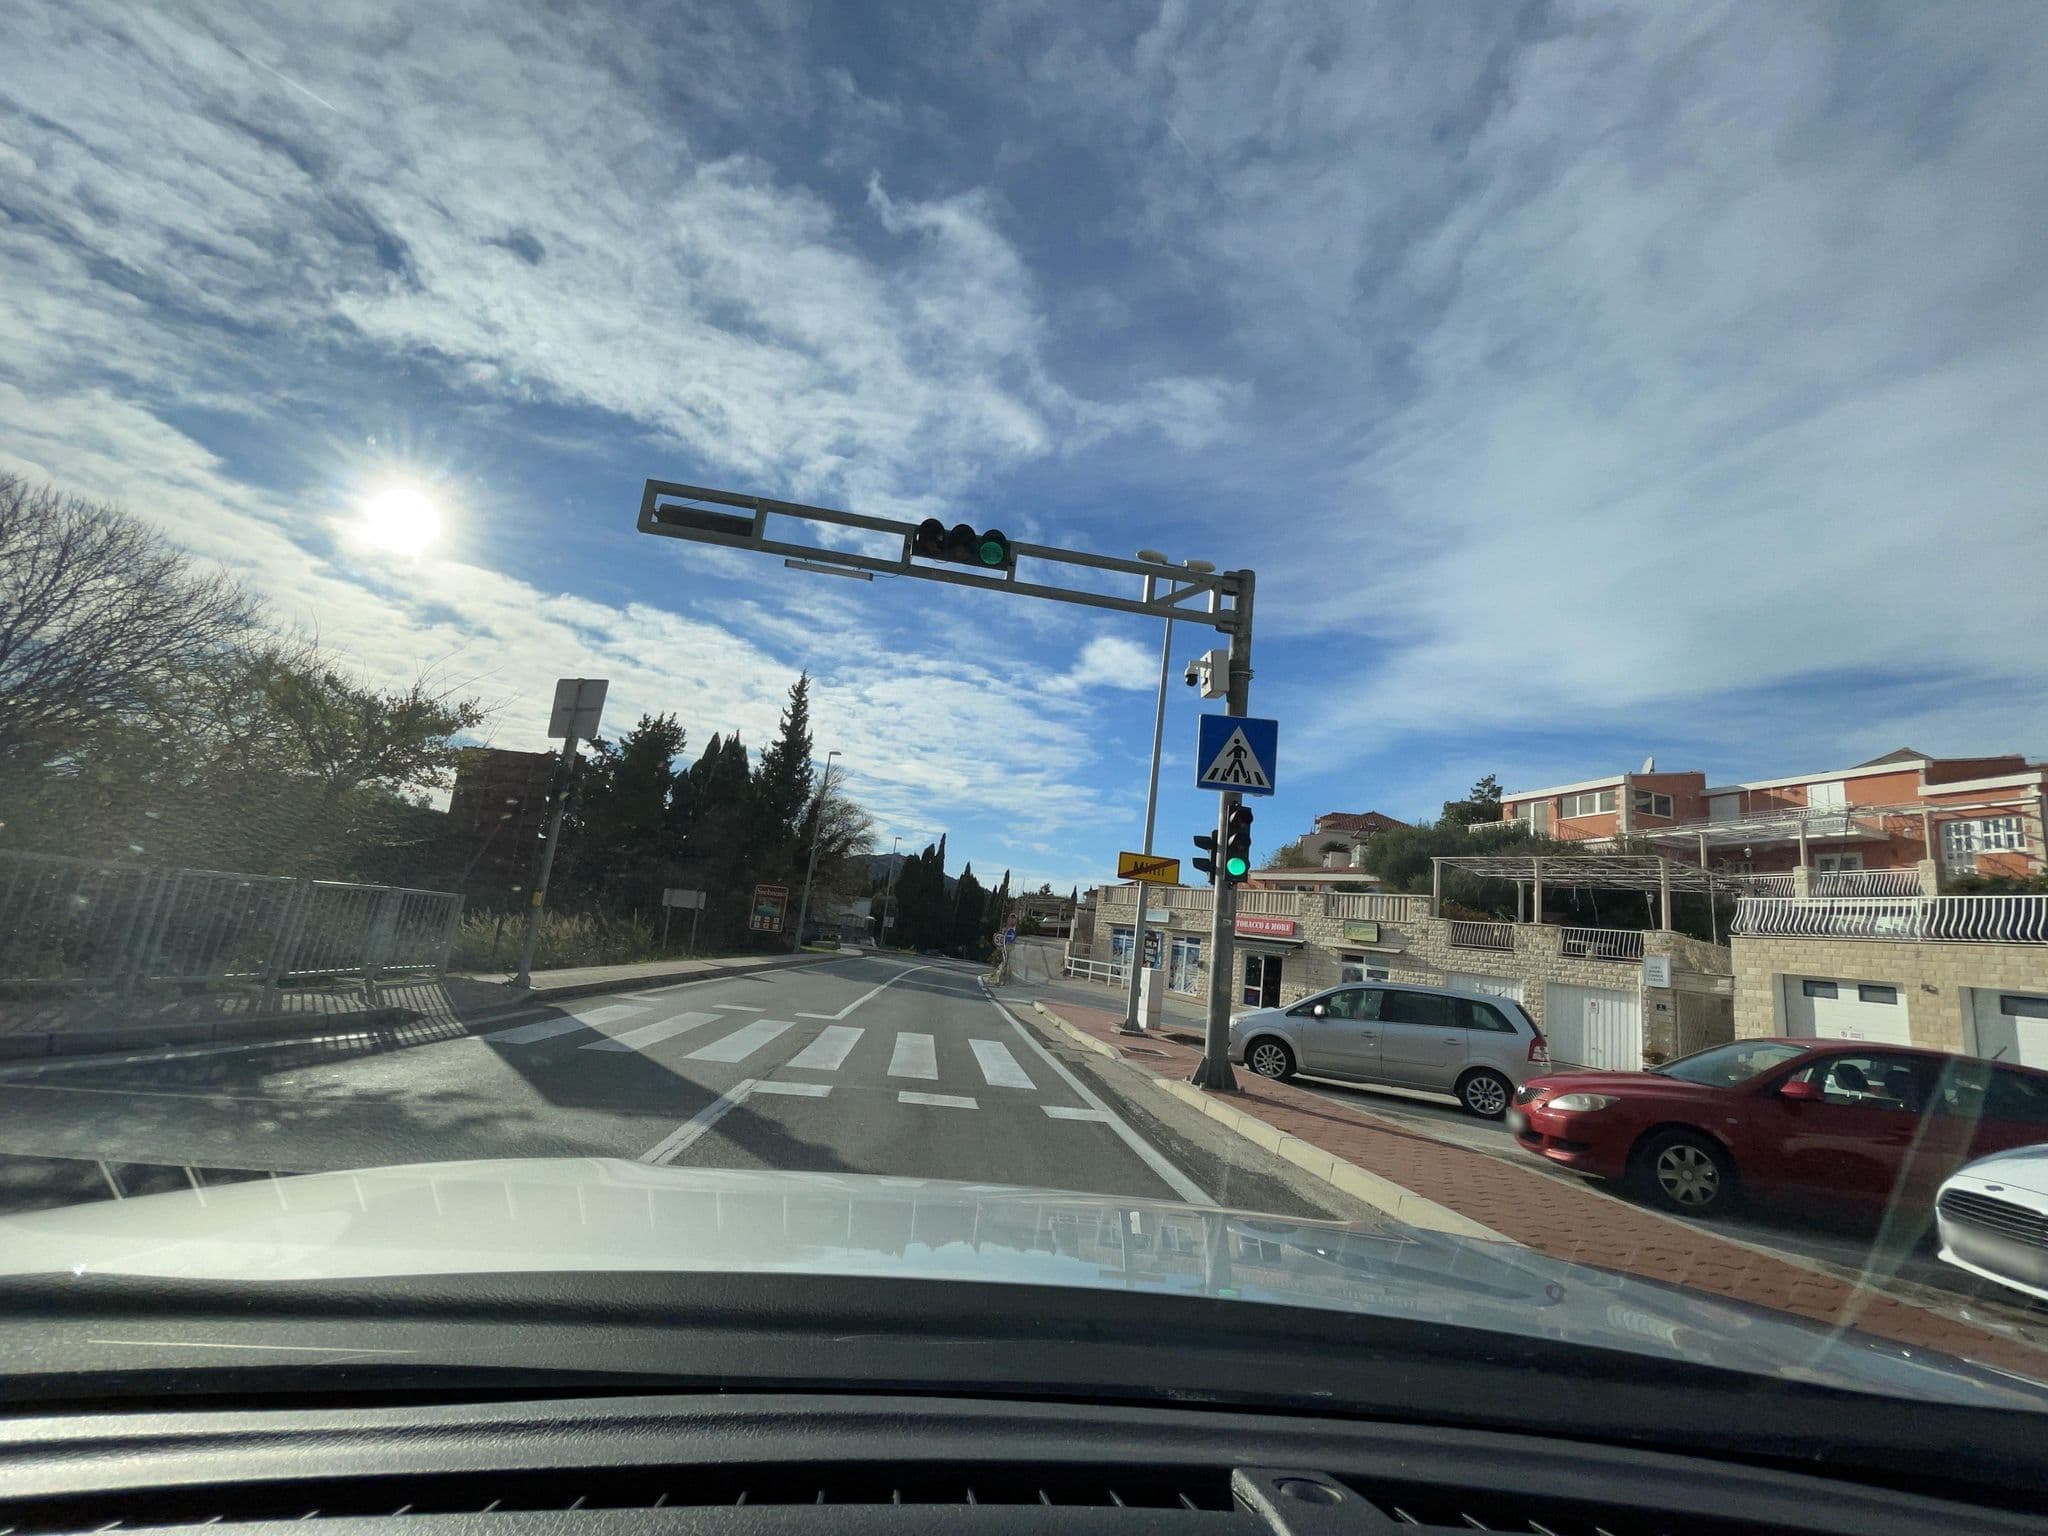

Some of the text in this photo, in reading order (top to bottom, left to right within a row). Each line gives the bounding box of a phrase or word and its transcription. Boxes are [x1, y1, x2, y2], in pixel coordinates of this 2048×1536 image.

[1236, 920, 1290, 932] TOBACCO & MORE
